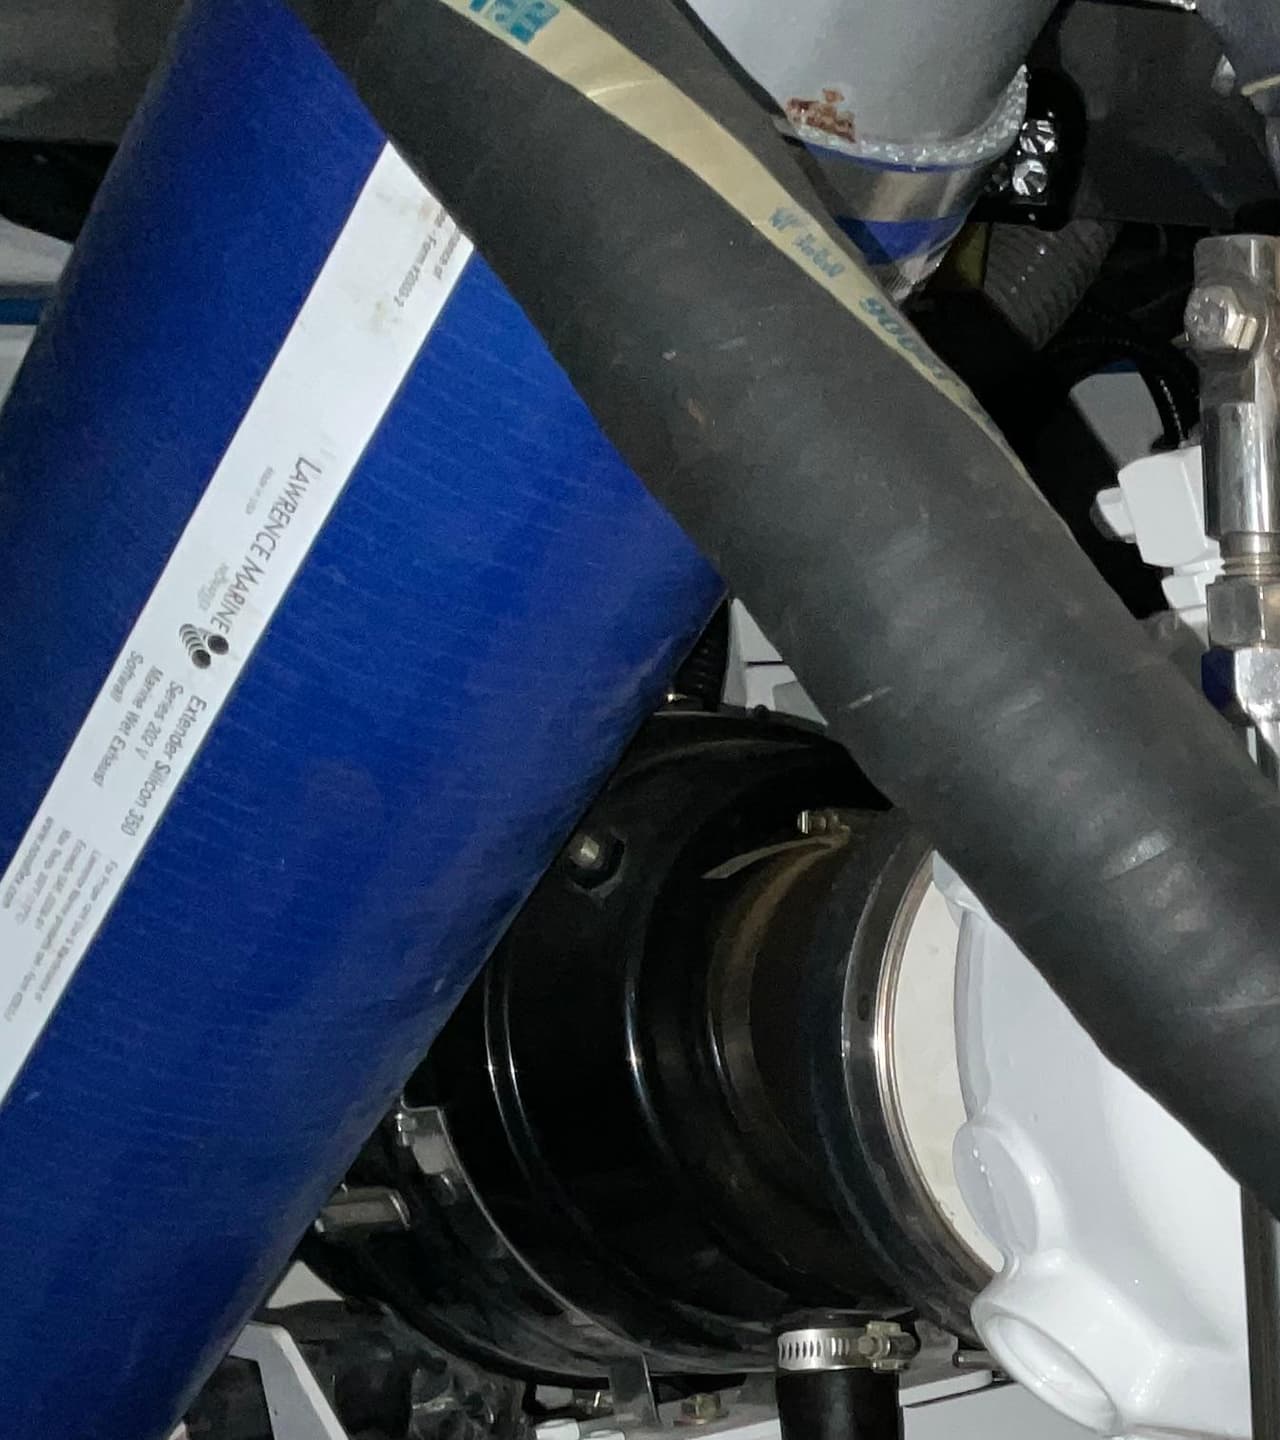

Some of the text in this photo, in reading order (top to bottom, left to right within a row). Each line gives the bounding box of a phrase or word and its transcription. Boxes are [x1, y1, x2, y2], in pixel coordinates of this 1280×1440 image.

[250, 457, 322, 561] LAWRENCE
[210, 556, 264, 634] MARINE
[110, 651, 144, 703] Softwall
[135, 680, 184, 760] Series 202 V
[92, 666, 163, 787] Marine Wet Exhaust
[121, 695, 207, 836] Extender Silicon 350
